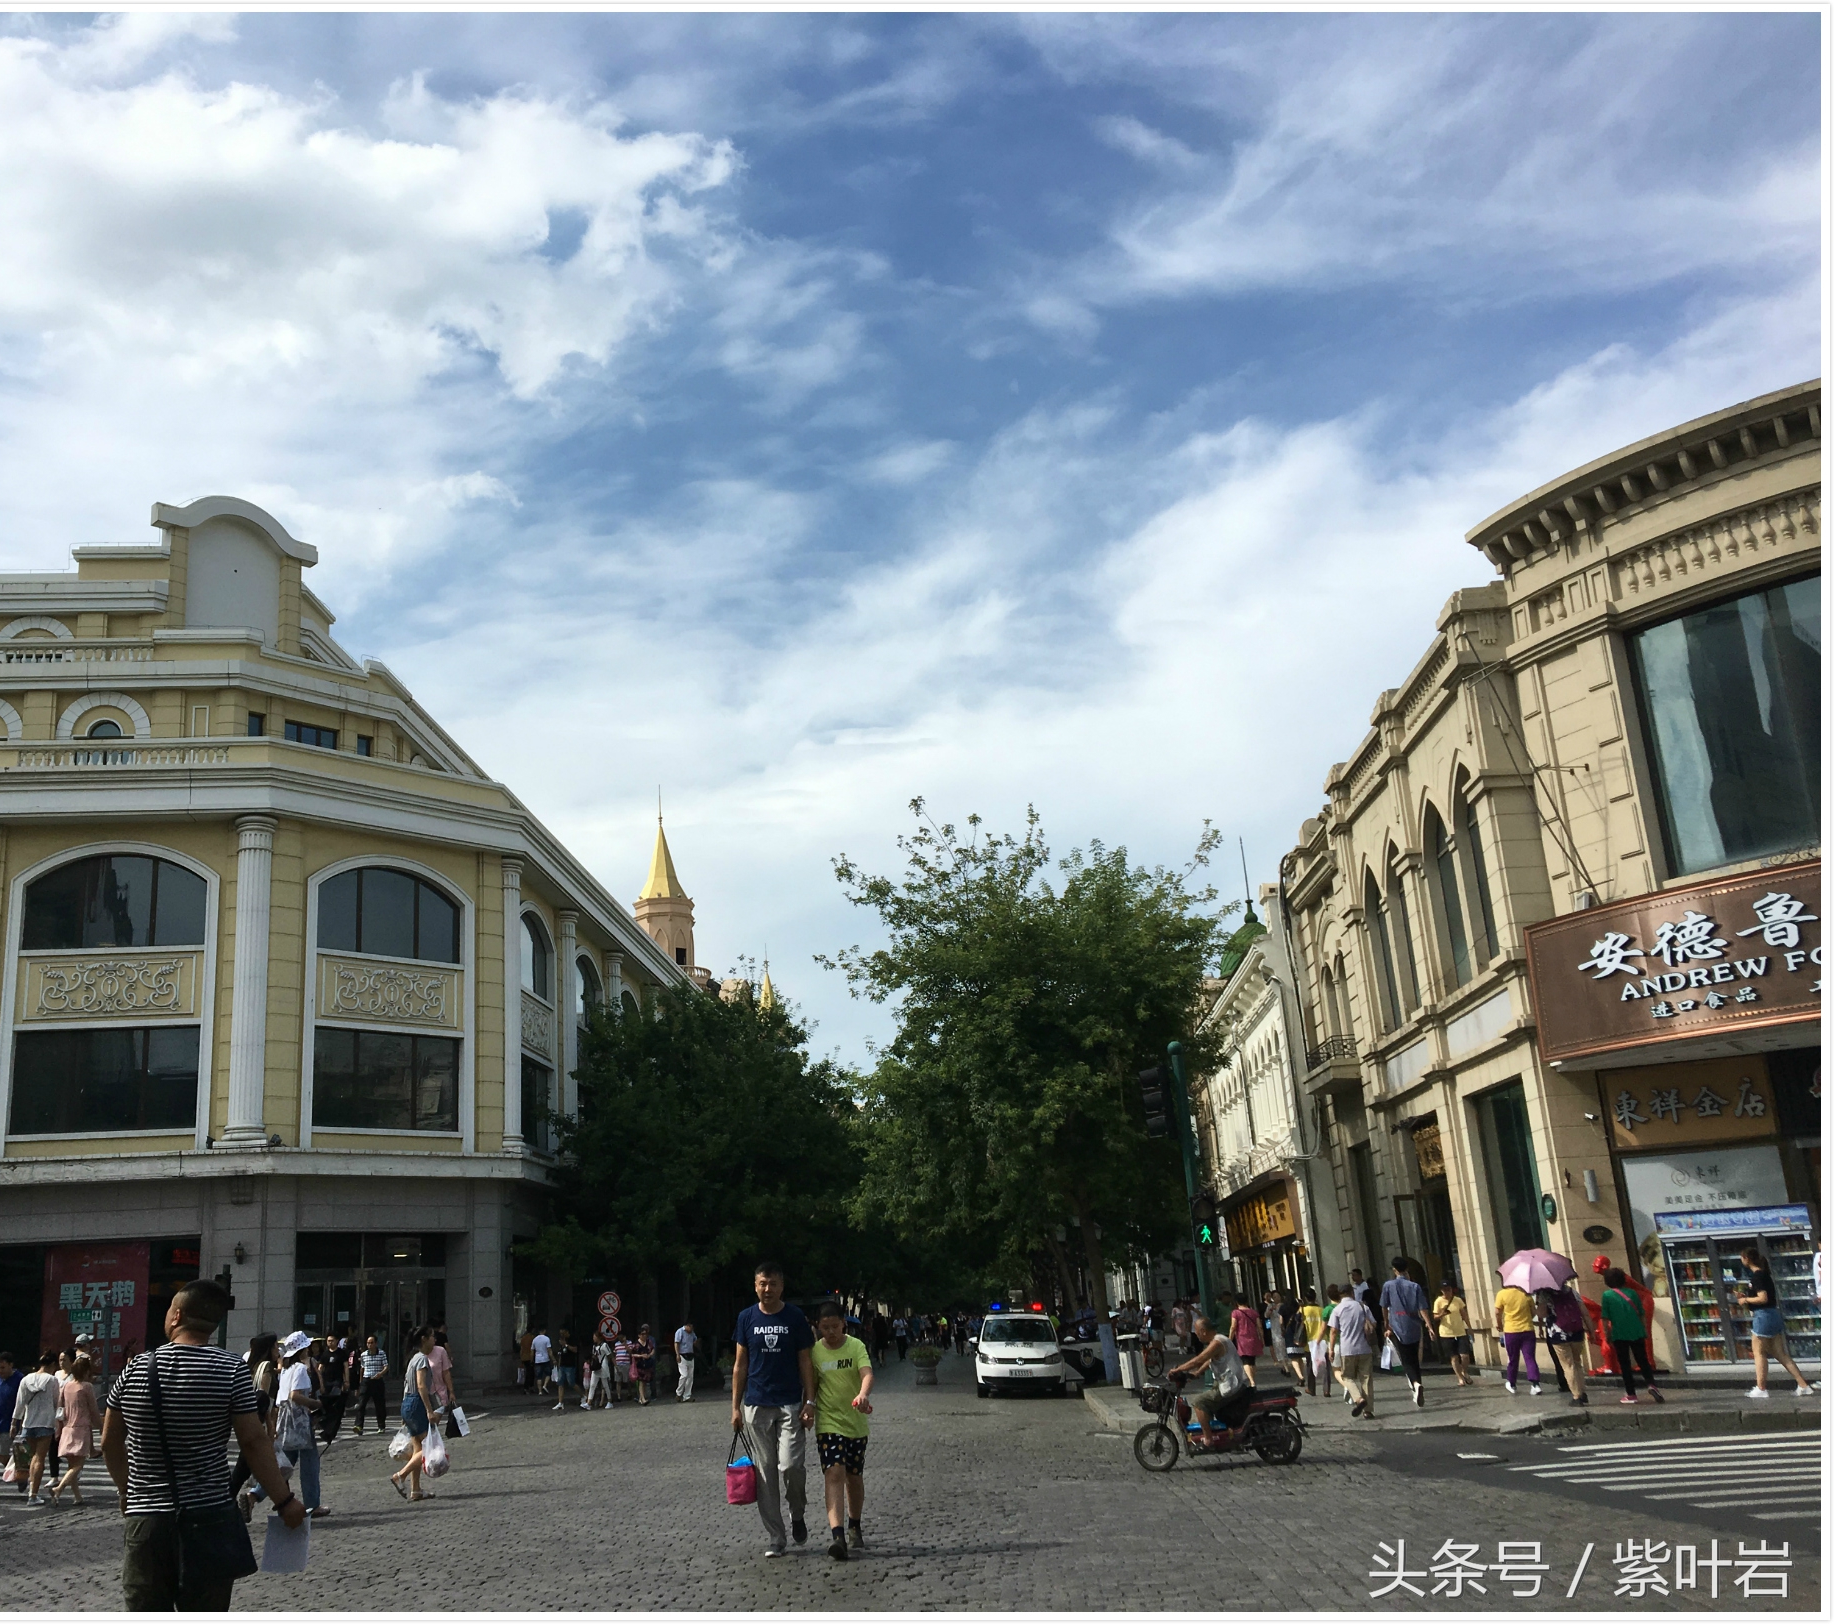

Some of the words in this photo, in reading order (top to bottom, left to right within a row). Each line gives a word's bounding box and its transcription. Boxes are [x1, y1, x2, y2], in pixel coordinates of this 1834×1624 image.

[1578, 891, 1819, 979] 安德鲁
[1620, 955, 1768, 1002] ANDREW
[1650, 986, 1757, 1019] 进口食品
[1614, 1077, 1766, 1130] 東祥金店
[59, 1280, 135, 1310] 黑天鹅
[754, 1326, 789, 1335] RAIDERS
